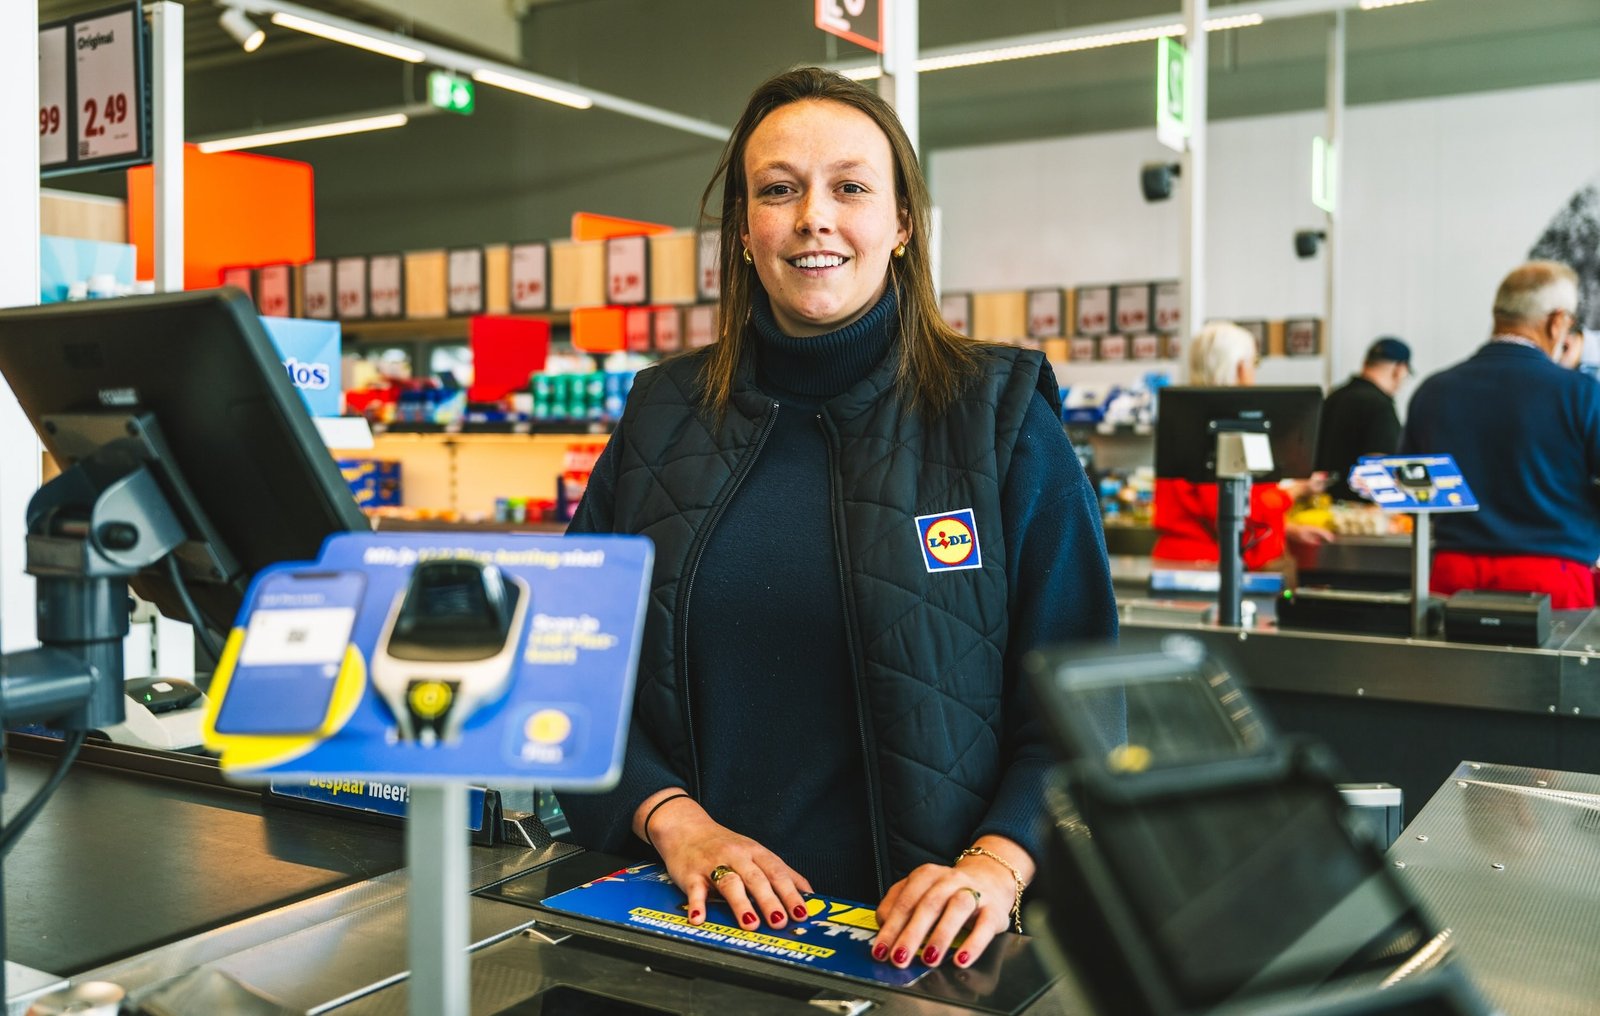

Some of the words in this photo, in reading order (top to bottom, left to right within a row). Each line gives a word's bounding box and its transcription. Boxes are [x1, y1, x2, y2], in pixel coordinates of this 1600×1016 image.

[78, 30, 114, 50] Original
[84, 93, 127, 137] 2.49
[369, 781, 410, 803] meer!
[638, 908, 690, 924] LANTEN
[696, 930, 727, 942] HET
[725, 937, 760, 949] AAN
[756, 944, 807, 960] KLANT
